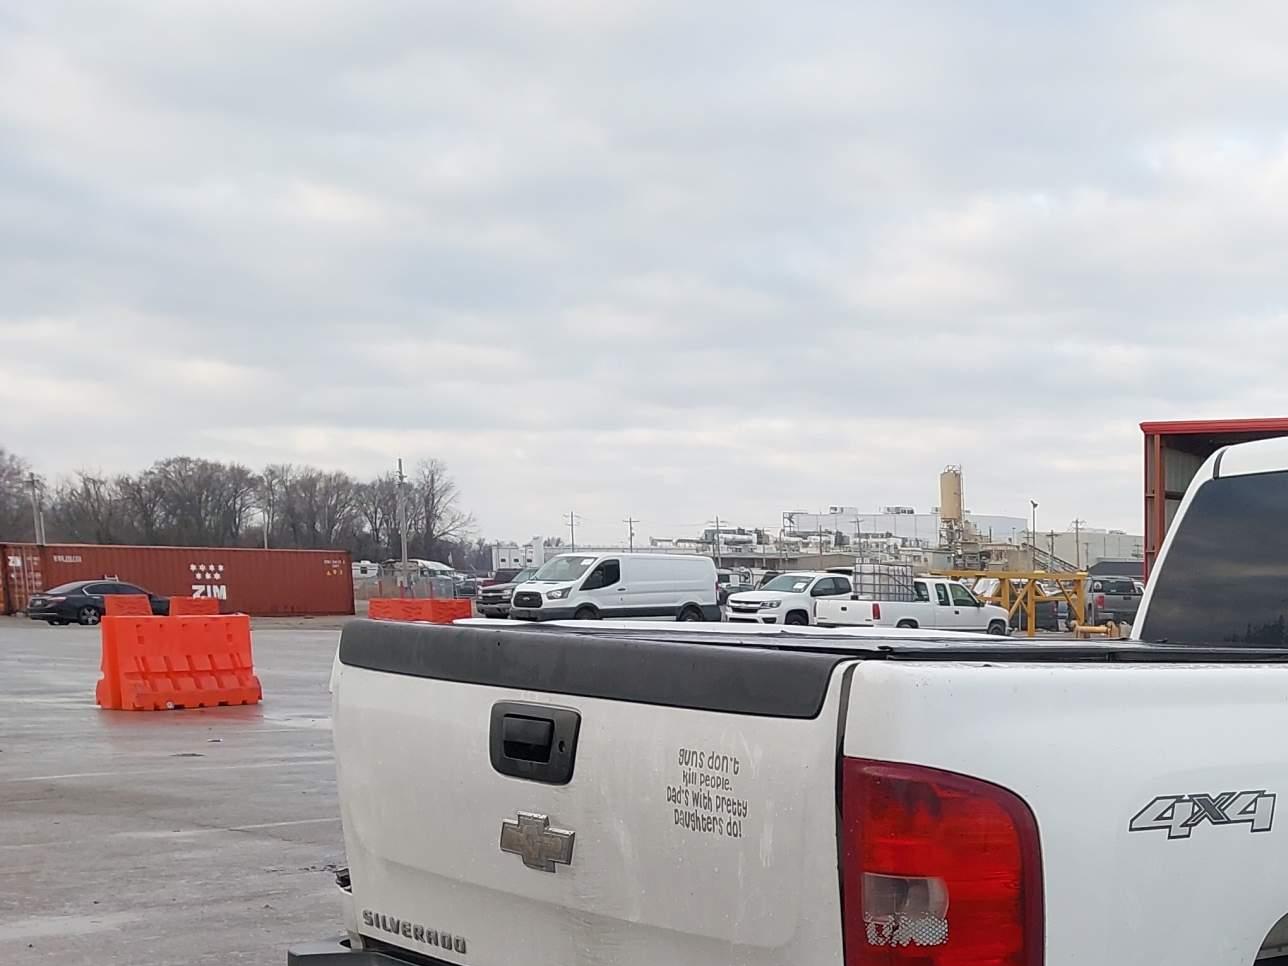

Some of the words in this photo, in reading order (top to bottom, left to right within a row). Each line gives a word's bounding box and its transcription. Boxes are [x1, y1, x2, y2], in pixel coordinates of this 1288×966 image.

[192, 585, 227, 600] ZIM
[707, 751, 739, 775] don't
[726, 816, 742, 838] do!
[362, 909, 466, 954] SILVERADO
